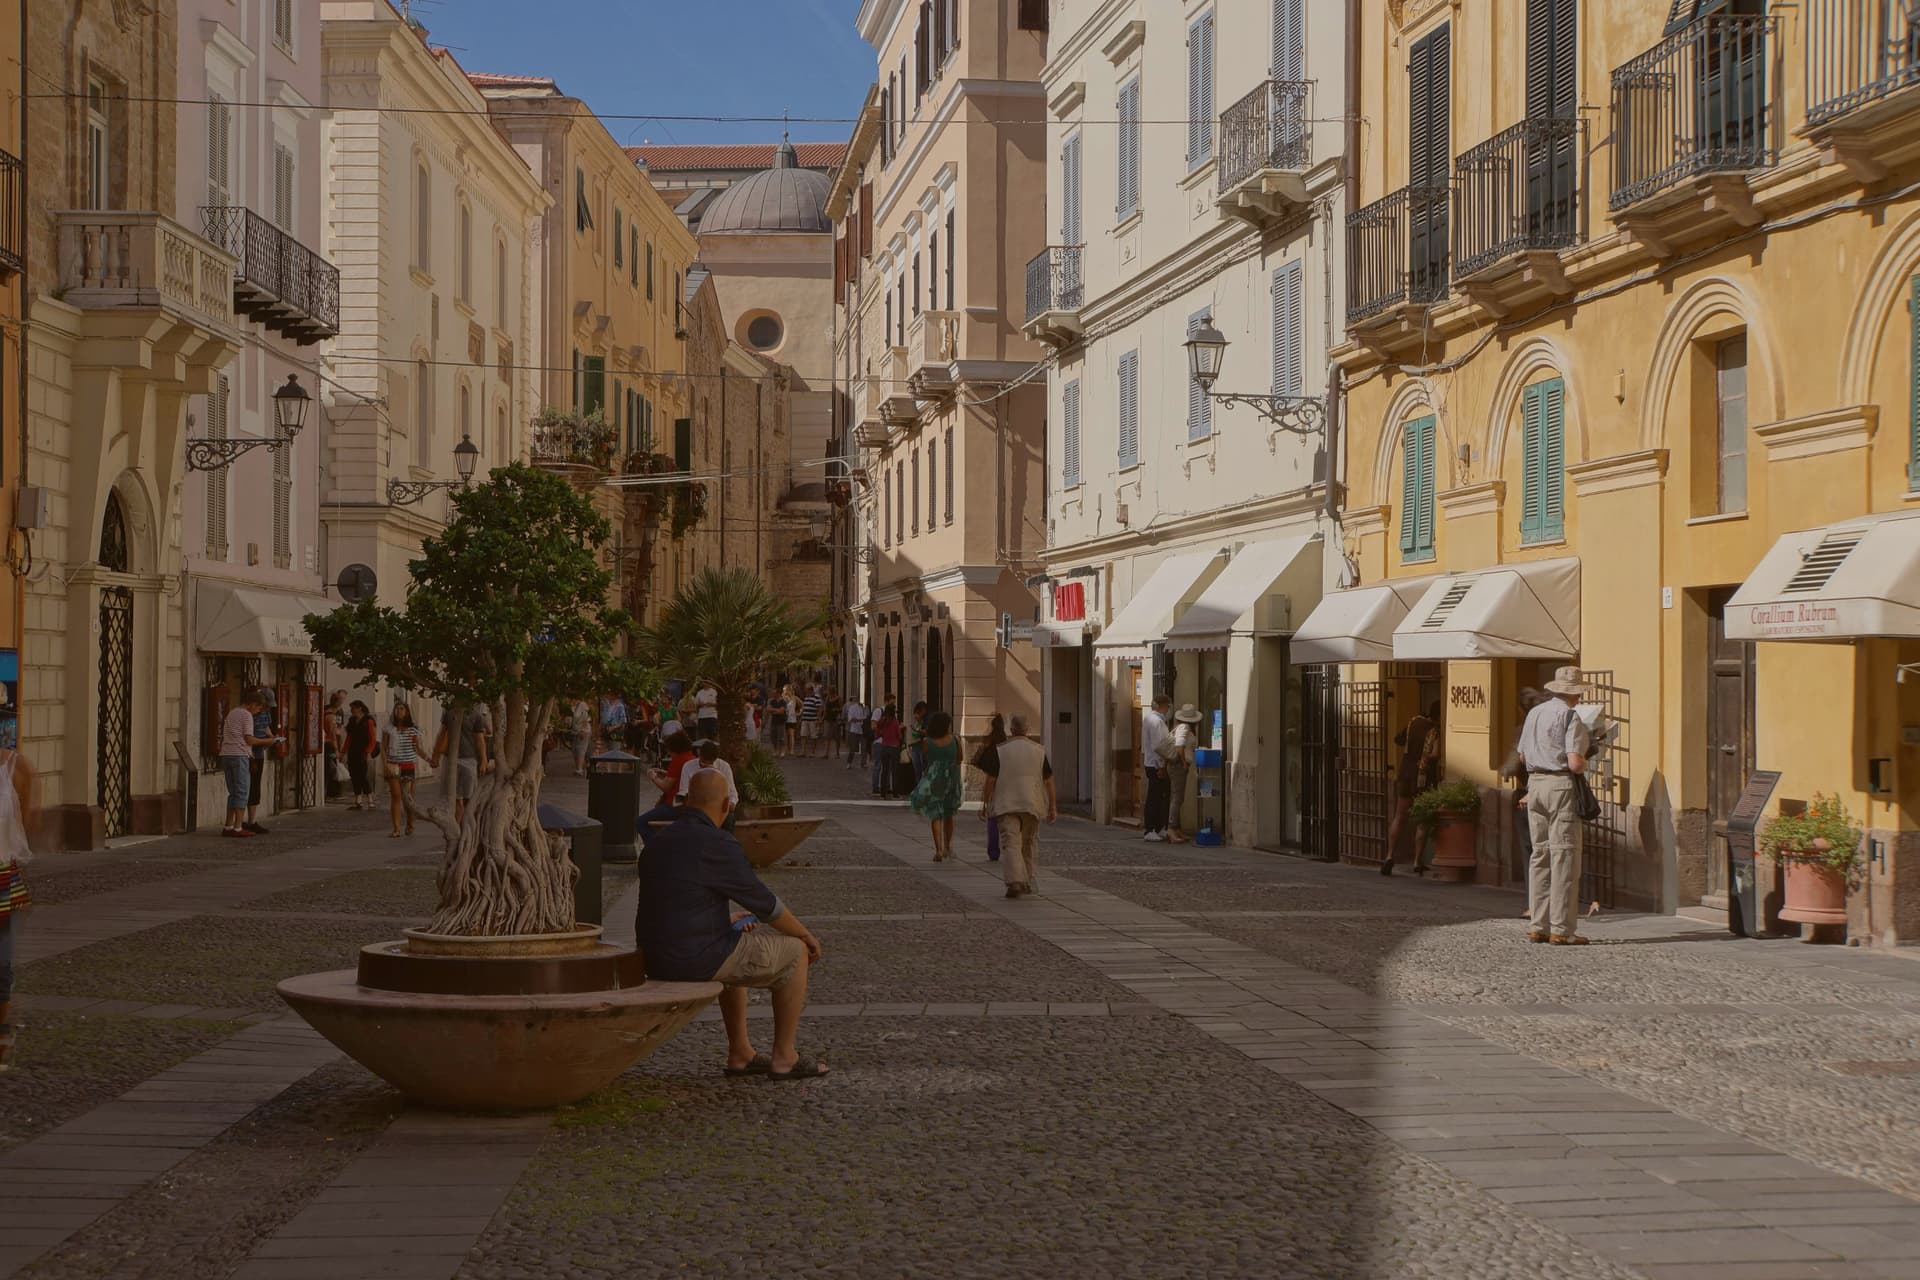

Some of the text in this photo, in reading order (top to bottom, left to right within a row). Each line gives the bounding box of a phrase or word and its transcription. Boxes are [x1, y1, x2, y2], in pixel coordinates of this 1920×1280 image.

[1751, 602, 1836, 625] Corallium Rubrum
[1451, 685, 1484, 704] SPELTA
